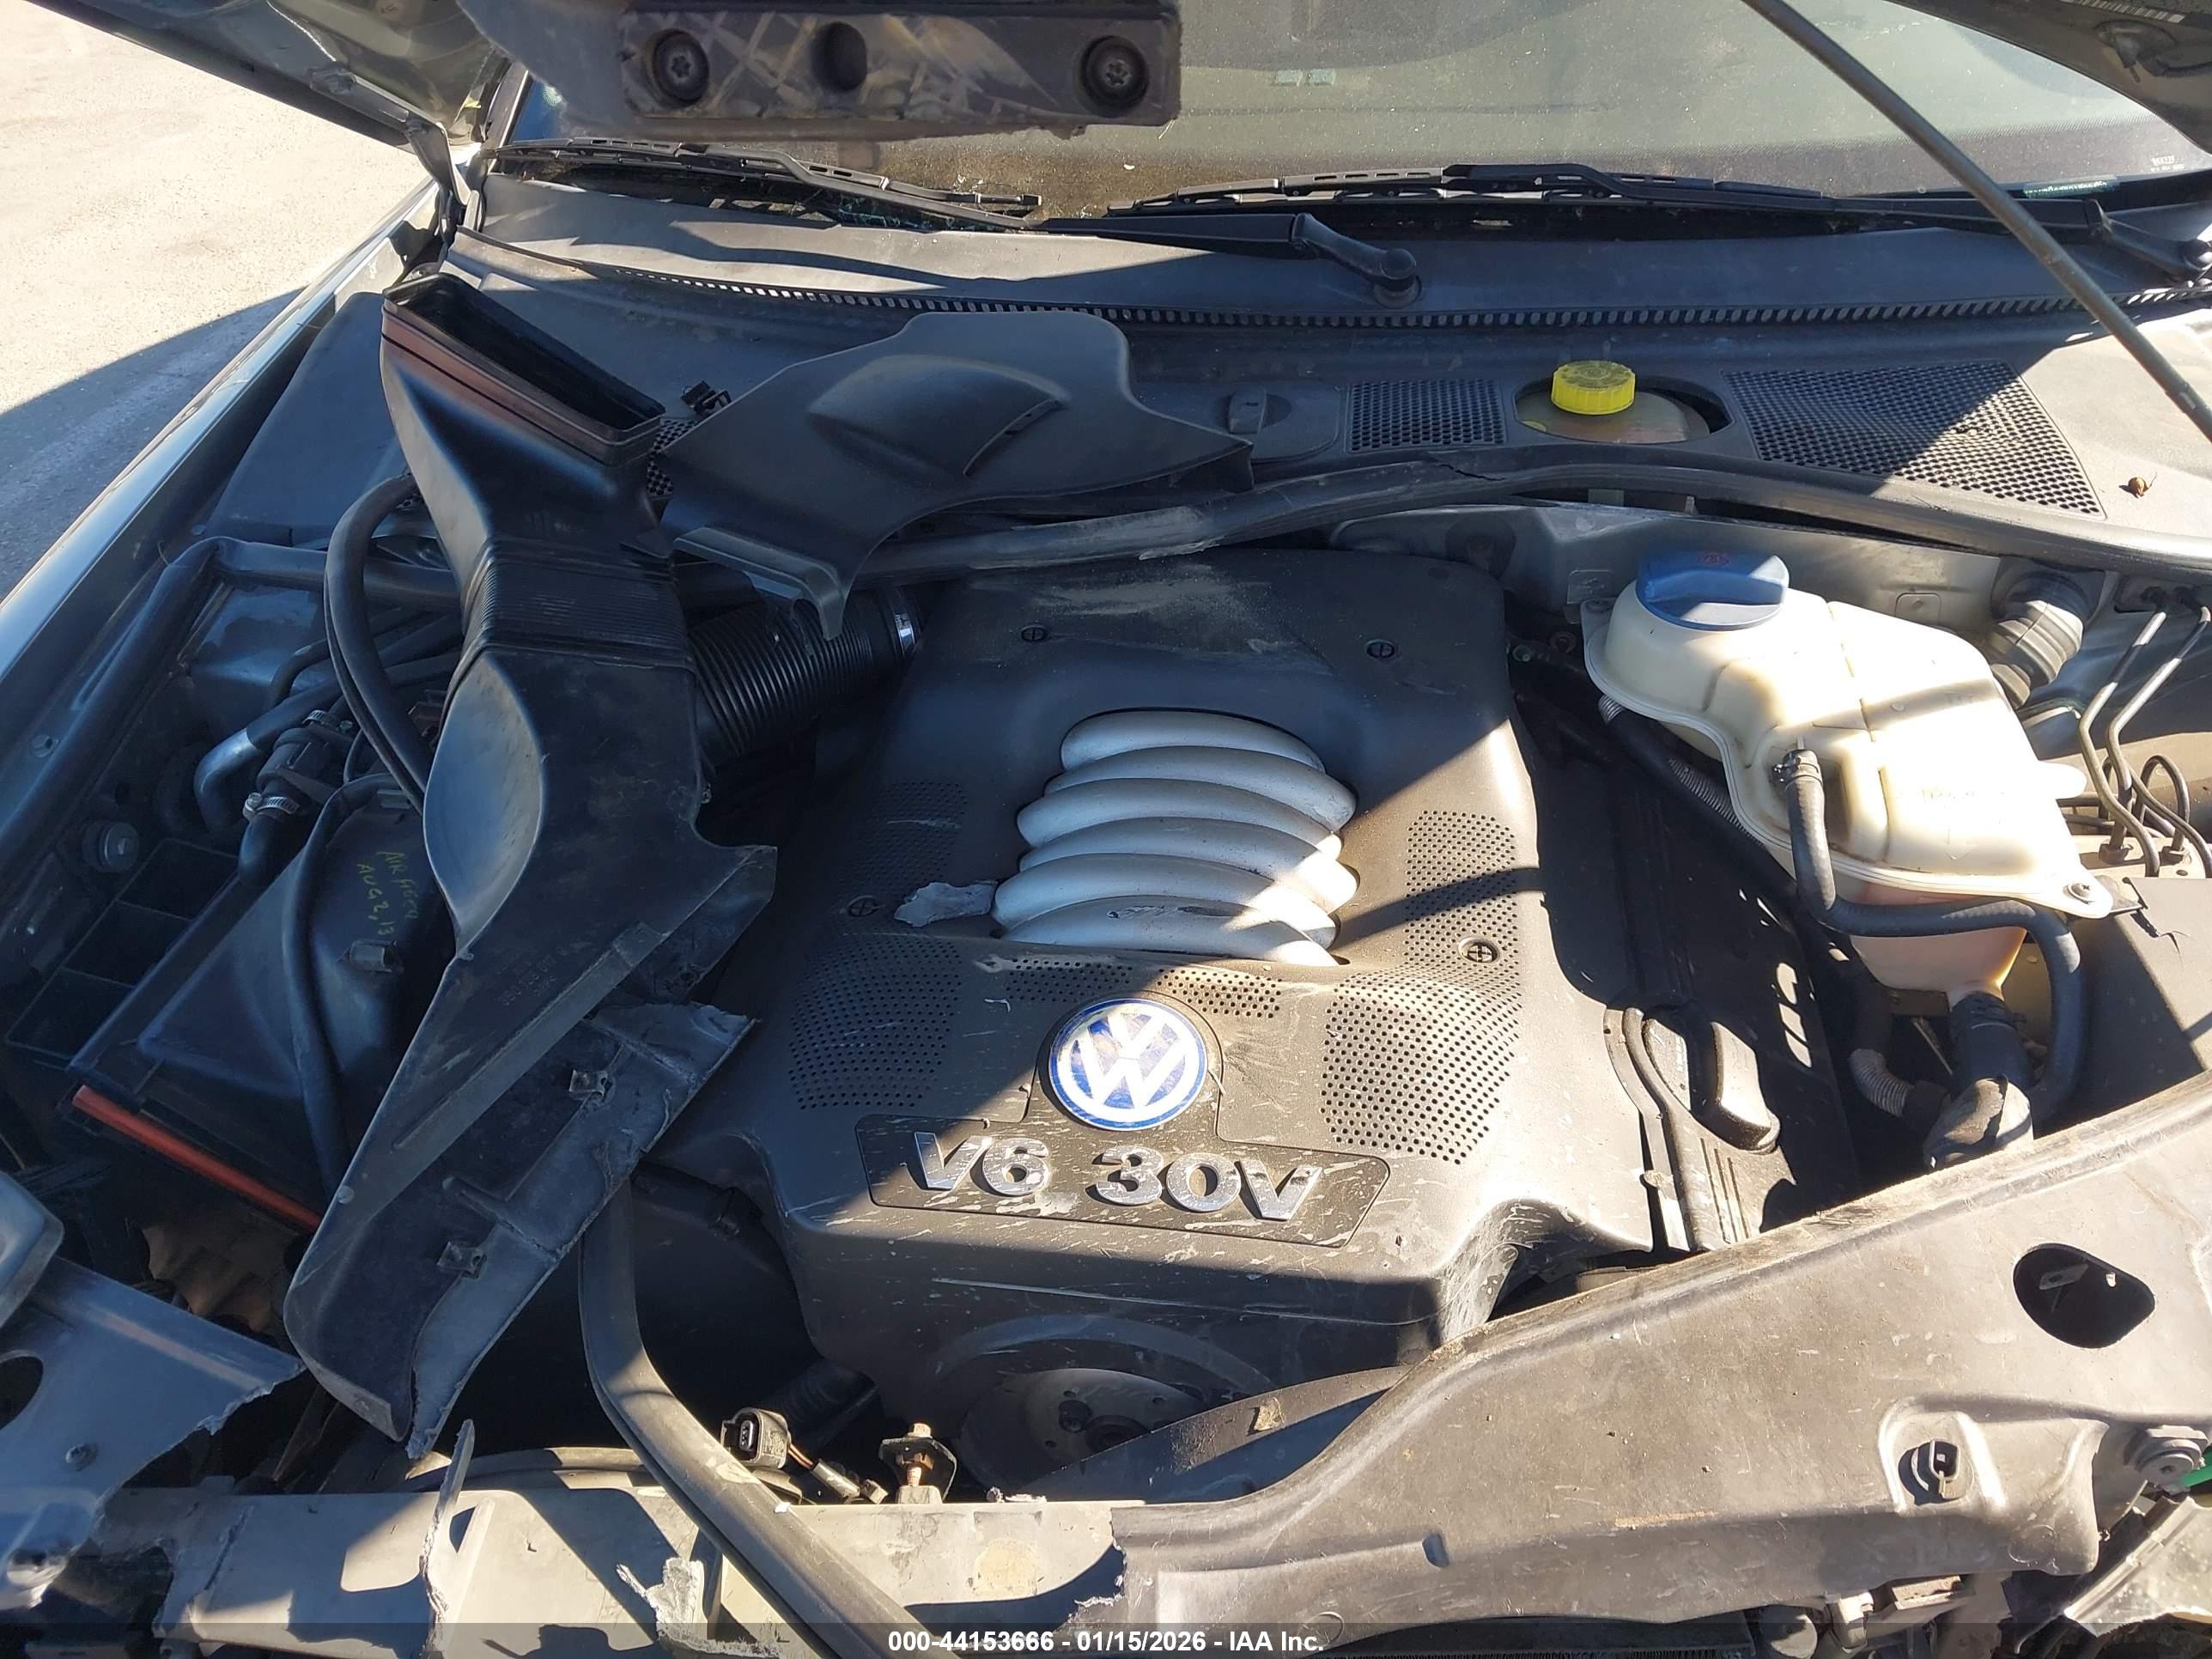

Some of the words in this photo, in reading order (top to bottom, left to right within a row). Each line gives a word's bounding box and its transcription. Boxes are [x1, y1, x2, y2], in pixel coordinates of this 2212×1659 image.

[1063, 1006, 1197, 1120] VW
[914, 1131, 1050, 1197] V6
[1091, 1145, 1323, 1222] 30V
